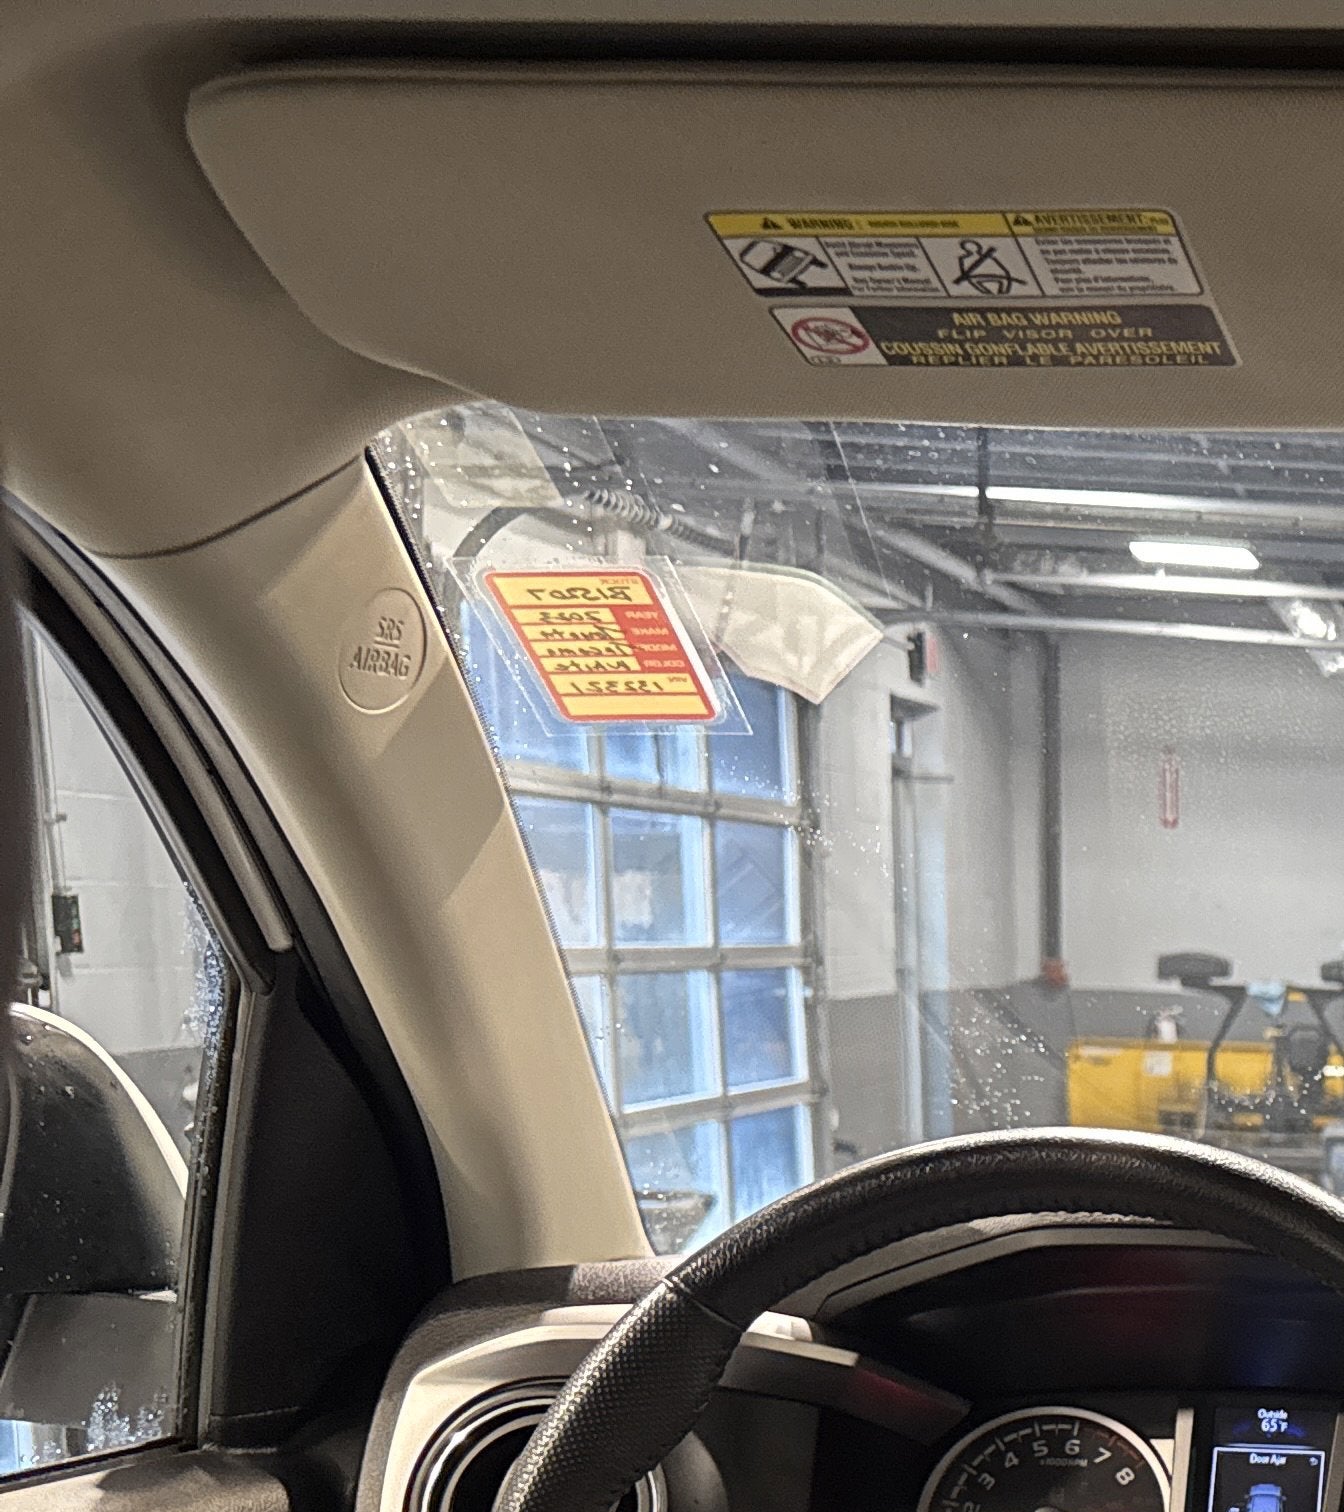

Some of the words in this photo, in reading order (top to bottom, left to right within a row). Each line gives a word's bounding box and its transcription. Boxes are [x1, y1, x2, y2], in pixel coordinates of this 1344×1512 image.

[952, 311, 983, 326] AIR
[988, 311, 1029, 326] BAG
[1031, 310, 1122, 325] WARNING
[937, 328, 987, 339] FLIP
[1004, 328, 1073, 340] VISOR
[1090, 327, 1153, 338] OVER
[880, 341, 964, 356] COUSSIN
[965, 342, 1074, 356] GONFLABLE
[1074, 341, 1222, 356] AVERTISSEMENT
[1025, 355, 1054, 366] LE
[377, 616, 405, 641] SRS
[348, 646, 413, 678] AIRBAG
[1032, 1440, 1050, 1457] 5
[1064, 1440, 1081, 1456] 6
[1093, 1447, 1113, 1464] 7
[1004, 1451, 1020, 1468] 4
[978, 1472, 996, 1490] 3
[1115, 1467, 1136, 1486] 8
